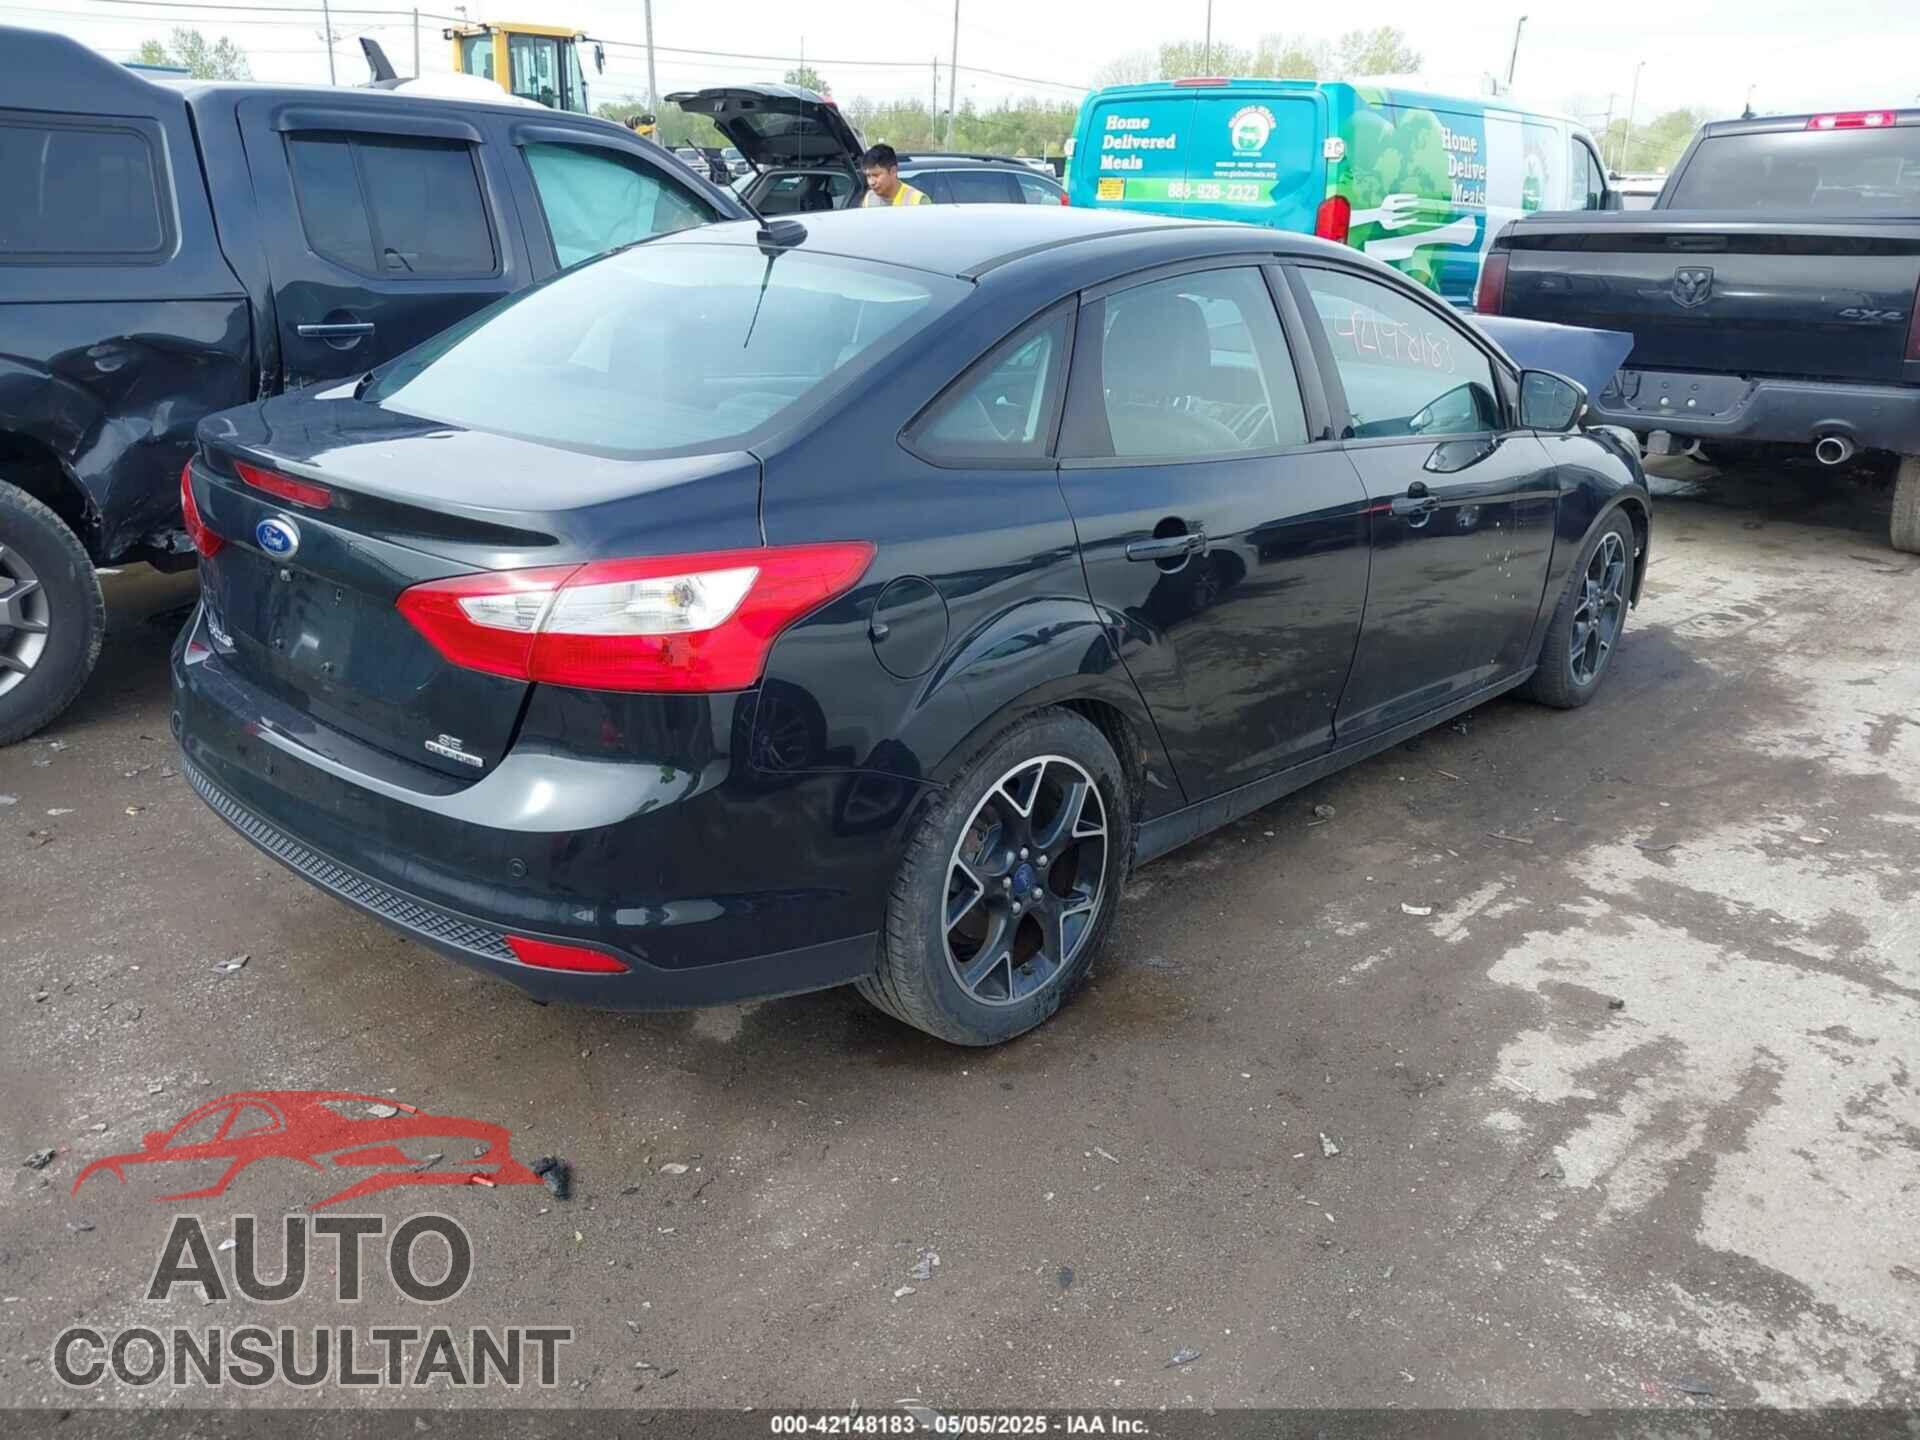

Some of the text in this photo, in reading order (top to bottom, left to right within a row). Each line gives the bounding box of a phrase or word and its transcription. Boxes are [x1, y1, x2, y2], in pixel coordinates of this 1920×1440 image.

[1105, 114, 1151, 131] Home
[1102, 133, 1177, 150] Delivered
[1441, 127, 1478, 153] Home
[1100, 154, 1144, 170] Meals
[1452, 181, 1486, 206] Meals
[438, 734, 463, 751] SE
